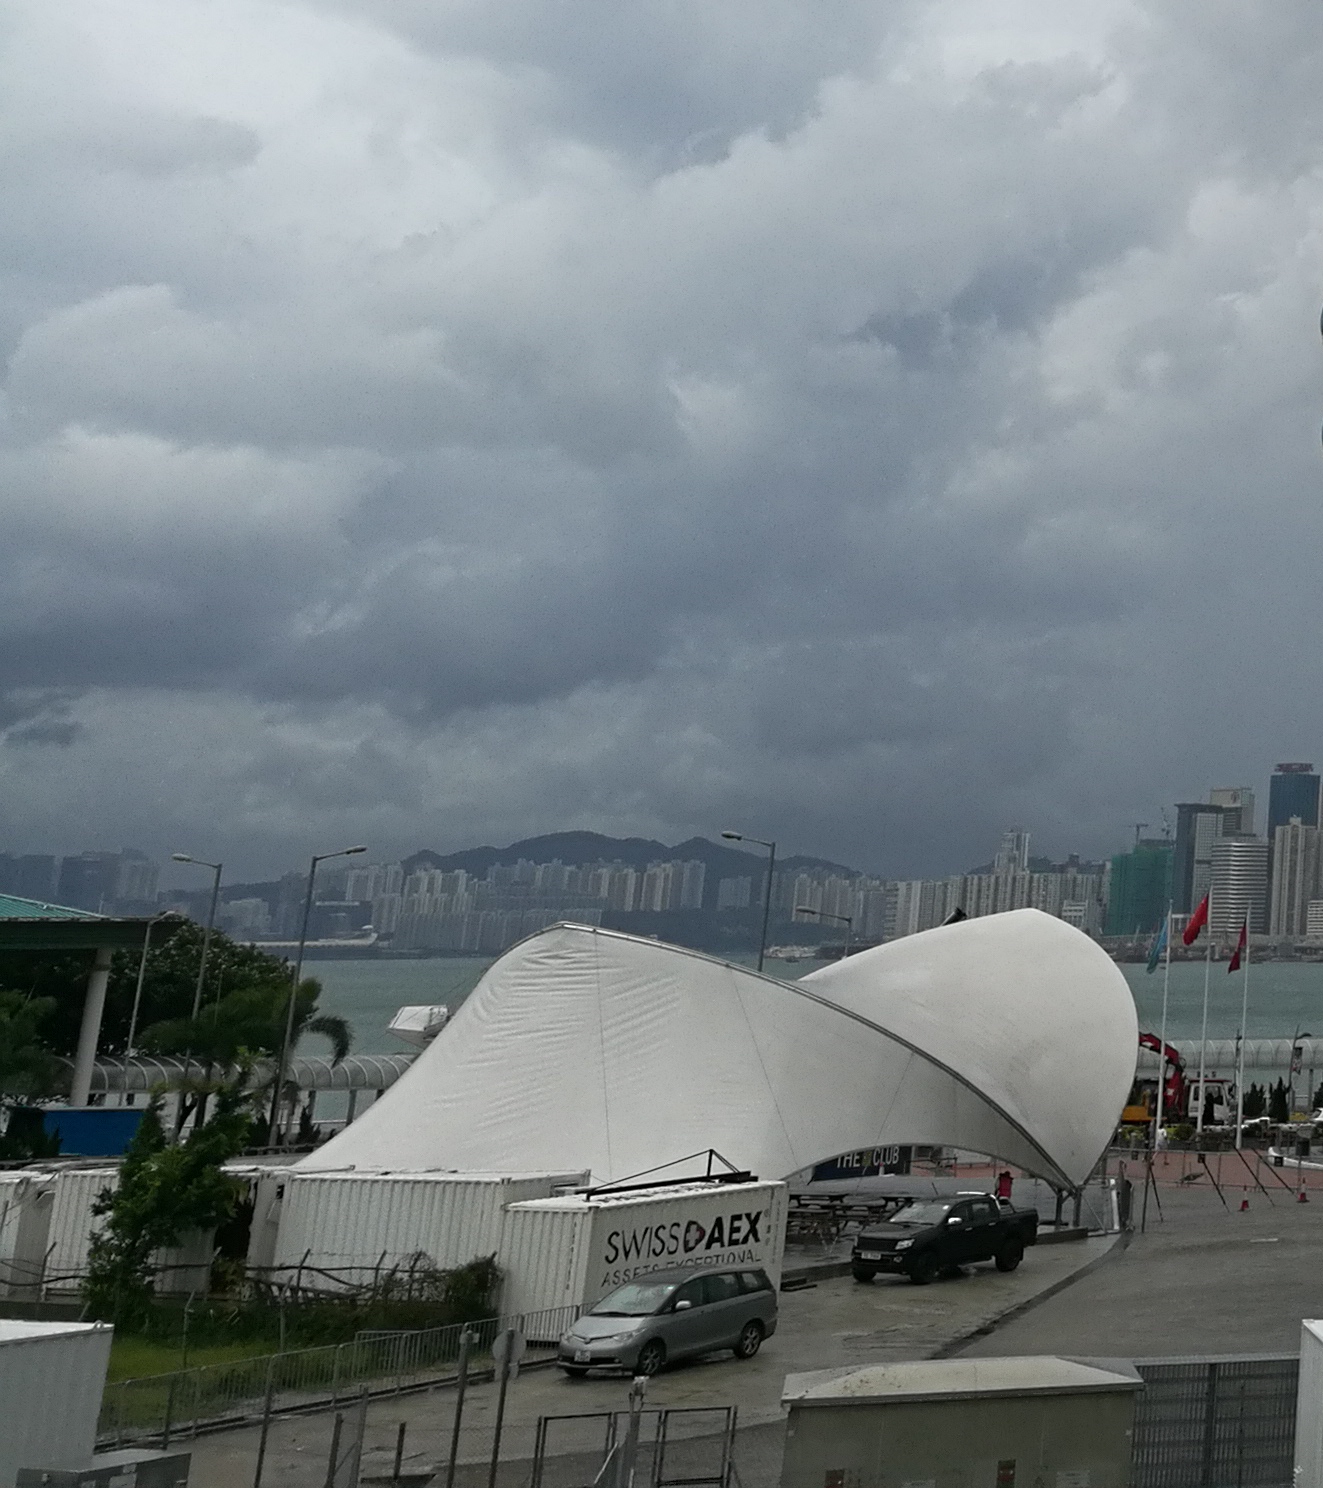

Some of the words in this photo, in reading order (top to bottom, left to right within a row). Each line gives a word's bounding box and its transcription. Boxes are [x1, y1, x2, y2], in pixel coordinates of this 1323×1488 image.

[836, 1154, 860, 1169] THE
[873, 1146, 900, 1166] CLUB
[605, 1222, 681, 1264] SWISS
[704, 1211, 762, 1250] AEX
